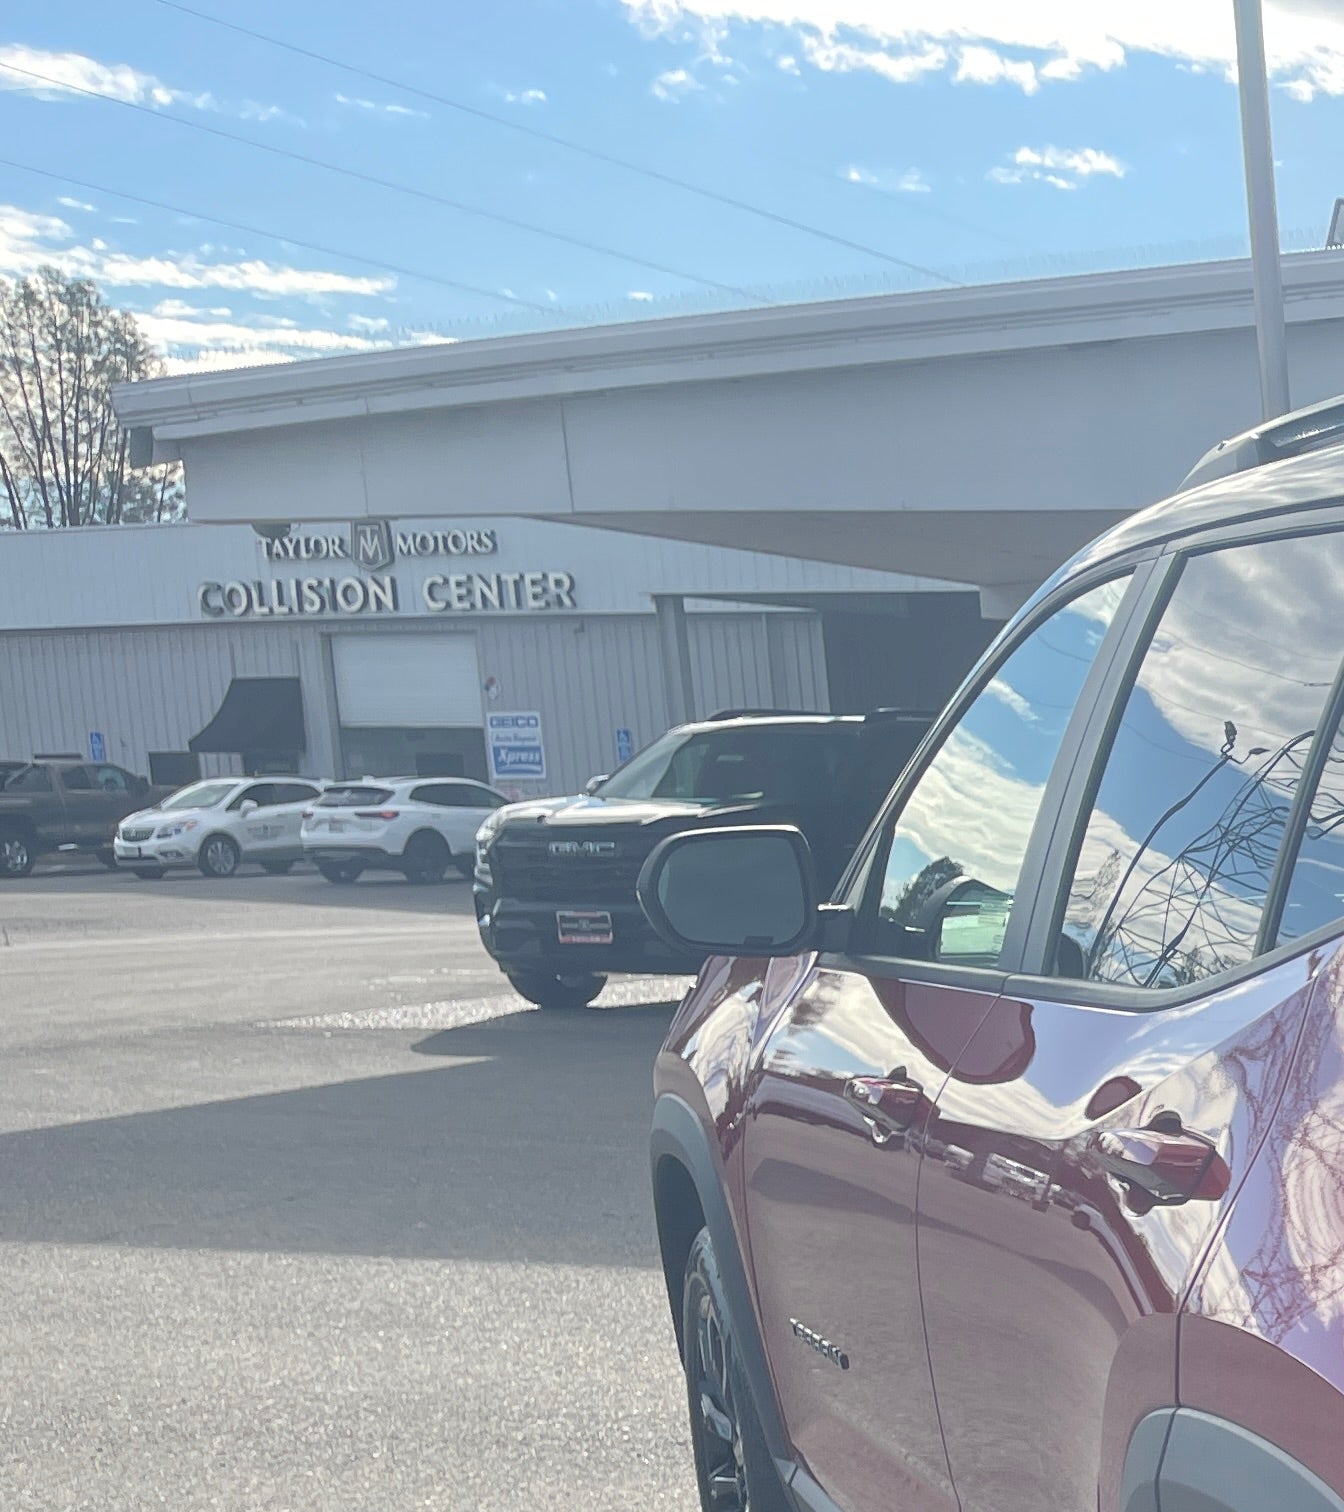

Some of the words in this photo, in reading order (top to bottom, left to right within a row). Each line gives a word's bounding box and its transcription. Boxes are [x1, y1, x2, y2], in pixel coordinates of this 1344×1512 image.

[258, 535, 346, 561] TAYLOR
[398, 528, 498, 558] MOTORS
[199, 573, 398, 618] COLLISION
[422, 570, 578, 611] CENTER
[490, 715, 539, 729] GEICO
